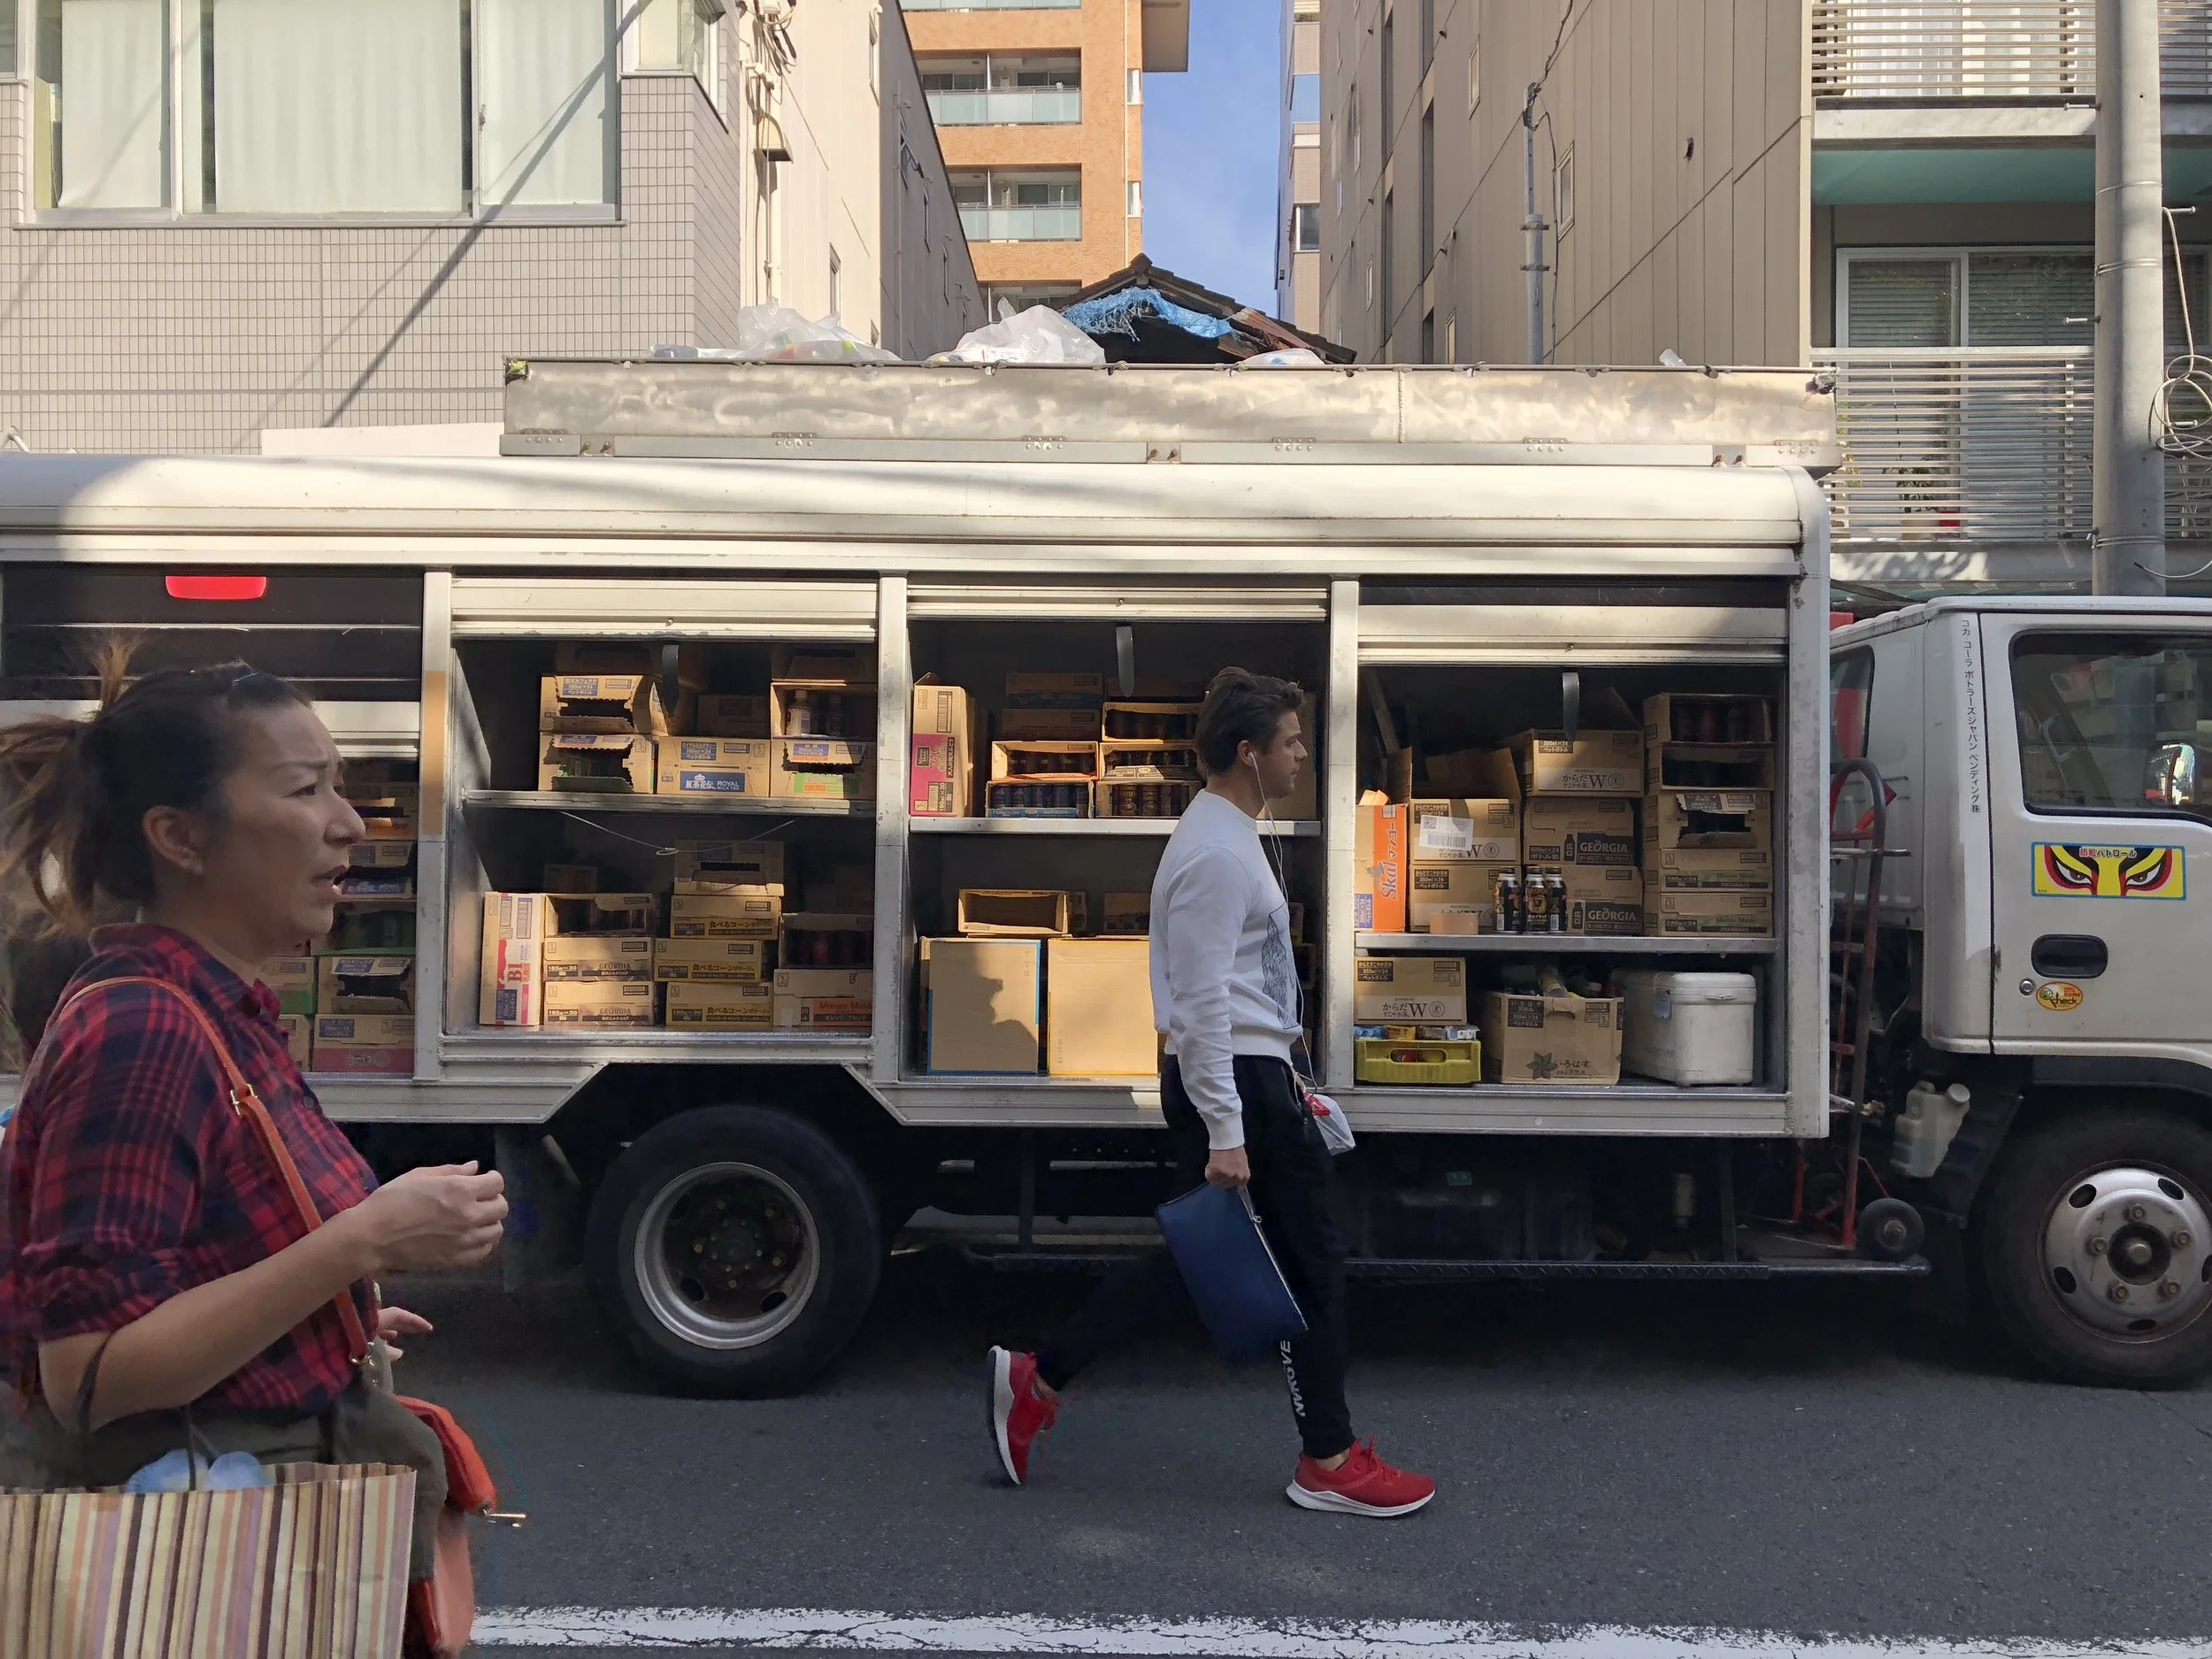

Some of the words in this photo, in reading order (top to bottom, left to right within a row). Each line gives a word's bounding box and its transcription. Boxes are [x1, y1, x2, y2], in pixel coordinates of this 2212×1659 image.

[1579, 841, 1628, 853] GEORGIA
[1588, 909, 1636, 921] GEORGIA
[1382, 1002, 1407, 1011] からだ
[1408, 1002, 1427, 1018] W
